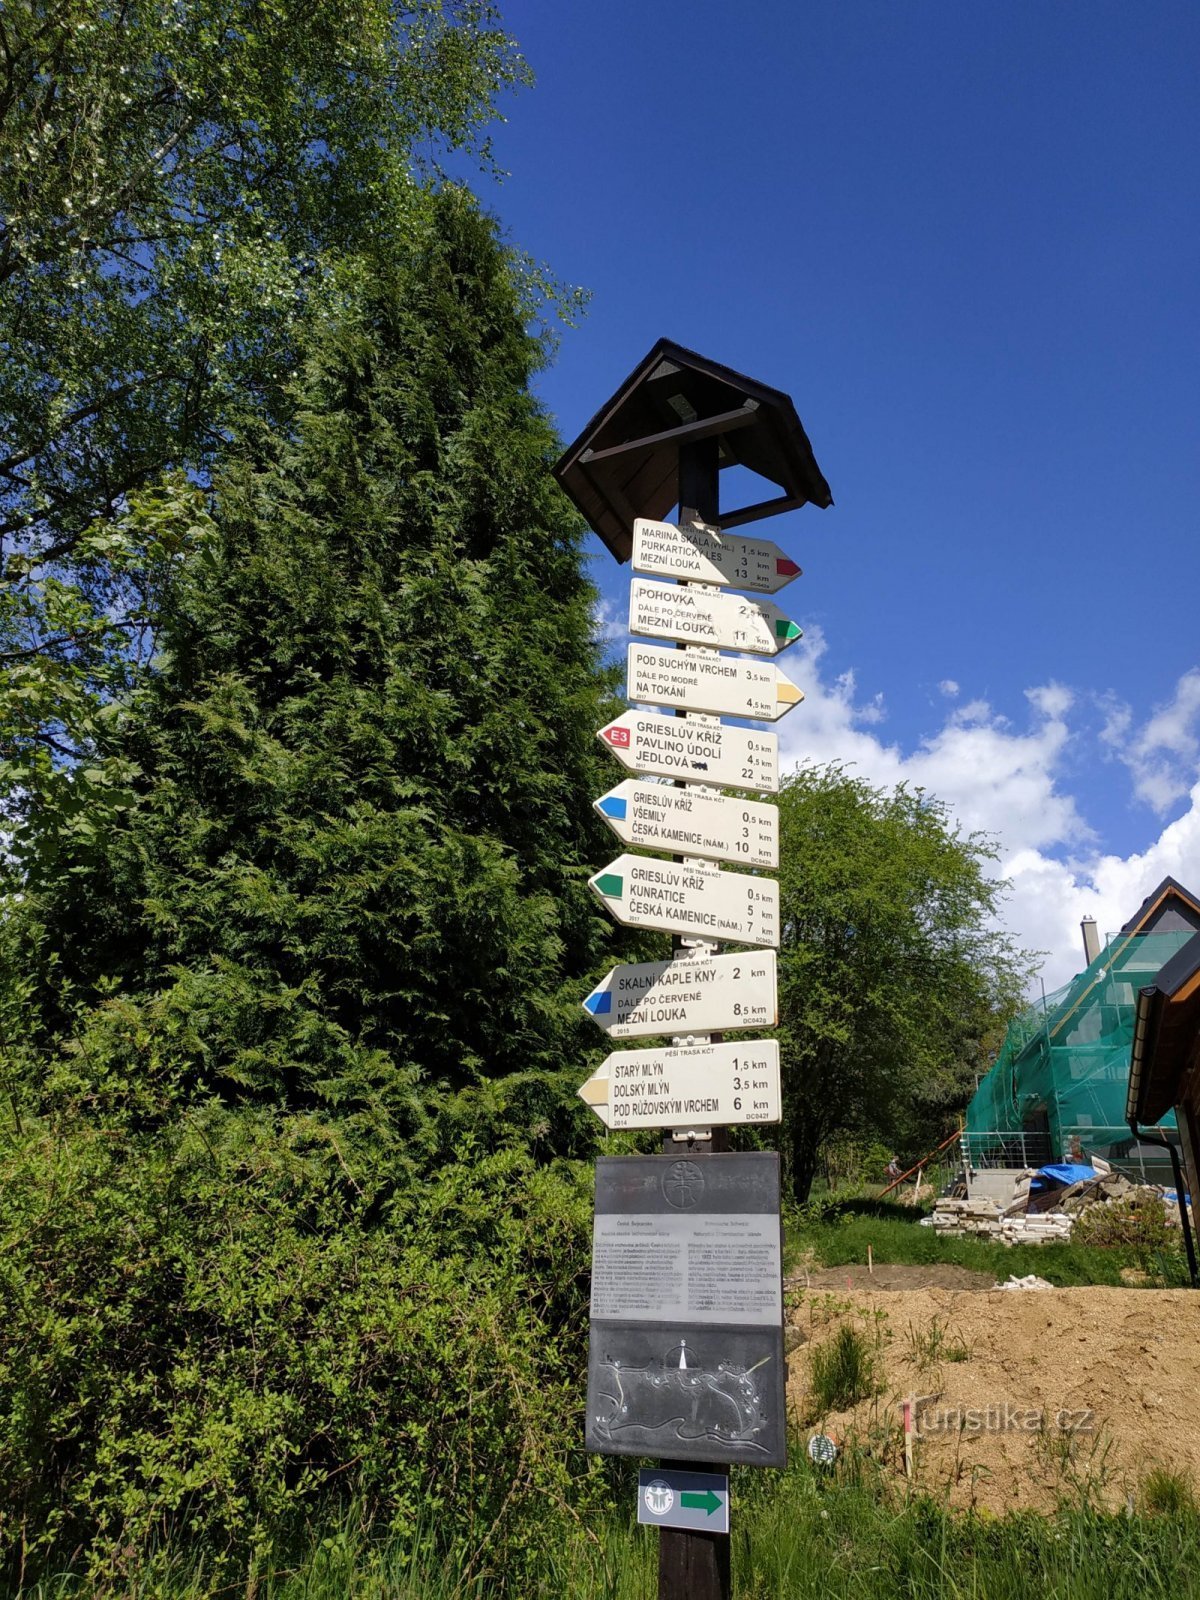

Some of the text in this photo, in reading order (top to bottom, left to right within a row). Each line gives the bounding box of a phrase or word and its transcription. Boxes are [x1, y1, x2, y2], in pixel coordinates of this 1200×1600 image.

[641, 539, 703, 557] PURKARTICKÝ
[706, 552, 722, 562] LES
[741, 557, 747, 566] 3
[642, 528, 677, 541] MARIINA
[681, 534, 709, 547] SKÁLA
[741, 545, 755, 555] 1,5
[640, 552, 667, 564] MEZNÍ
[670, 558, 700, 570] LOUKA
[735, 569, 747, 578] 13
[638, 603, 712, 622] DÁLE PO ČERVENÉ
[639, 588, 695, 606] POHOVKA
[757, 610, 769, 619] km
[638, 614, 769, 645] MEZNÍ LOUKA 11 km
[637, 655, 656, 665] POD
[659, 659, 696, 672] SUCHÝM
[700, 664, 737, 678] VRCHEM
[746, 671, 758, 681] 3,5
[637, 670, 656, 680] DÁLE
[671, 675, 698, 685] MODRÉ
[636, 682, 649, 692] NA
[652, 683, 685, 697] TOKÁNÍ
[747, 698, 759, 709] 4,5
[610, 730, 627, 742] E3
[637, 722, 693, 739] GRIESLŮV
[697, 730, 722, 745] KŘÍŽ
[748, 741, 759, 751] 0,5
[636, 736, 684, 752] PAVLINO
[687, 742, 721, 759] ÚDOLÍ
[748, 755, 760, 766] 4,5
[636, 751, 688, 768] JEDLOVÁ
[742, 768, 753, 779] 22
[633, 792, 771, 826] GRIESLŮV KŘÍŽ 0,5 km
[633, 807, 771, 841] VŠEMILY 3 km
[632, 821, 771, 857] ČESKÁ KAMENICE (NÁM.) 10 km
[631, 868, 773, 903] GRIESLŮV KŘÍŽ 0,5 km
[630, 884, 773, 919] KUNRATICE 5 km
[629, 900, 773, 936] ČESKÁ KAMENICE (NÁM.) 7 km
[619, 973, 655, 990] SKALNÍ
[658, 972, 691, 986] KAPLE
[695, 970, 717, 982] KNY
[733, 968, 740, 979] 2
[618, 991, 702, 1007] DÁLE PO ČERVENÉ
[617, 1003, 766, 1024] MEZNÍ LOUKA 8,5 km
[615, 1058, 767, 1078] STARÝ MLÝN 1,5 km
[614, 1078, 768, 1098] DOLSKÝ MLÝN 3,5 km
[614, 1097, 768, 1116] POD RŮŽOVSKÝM VRCHEM 6 km
